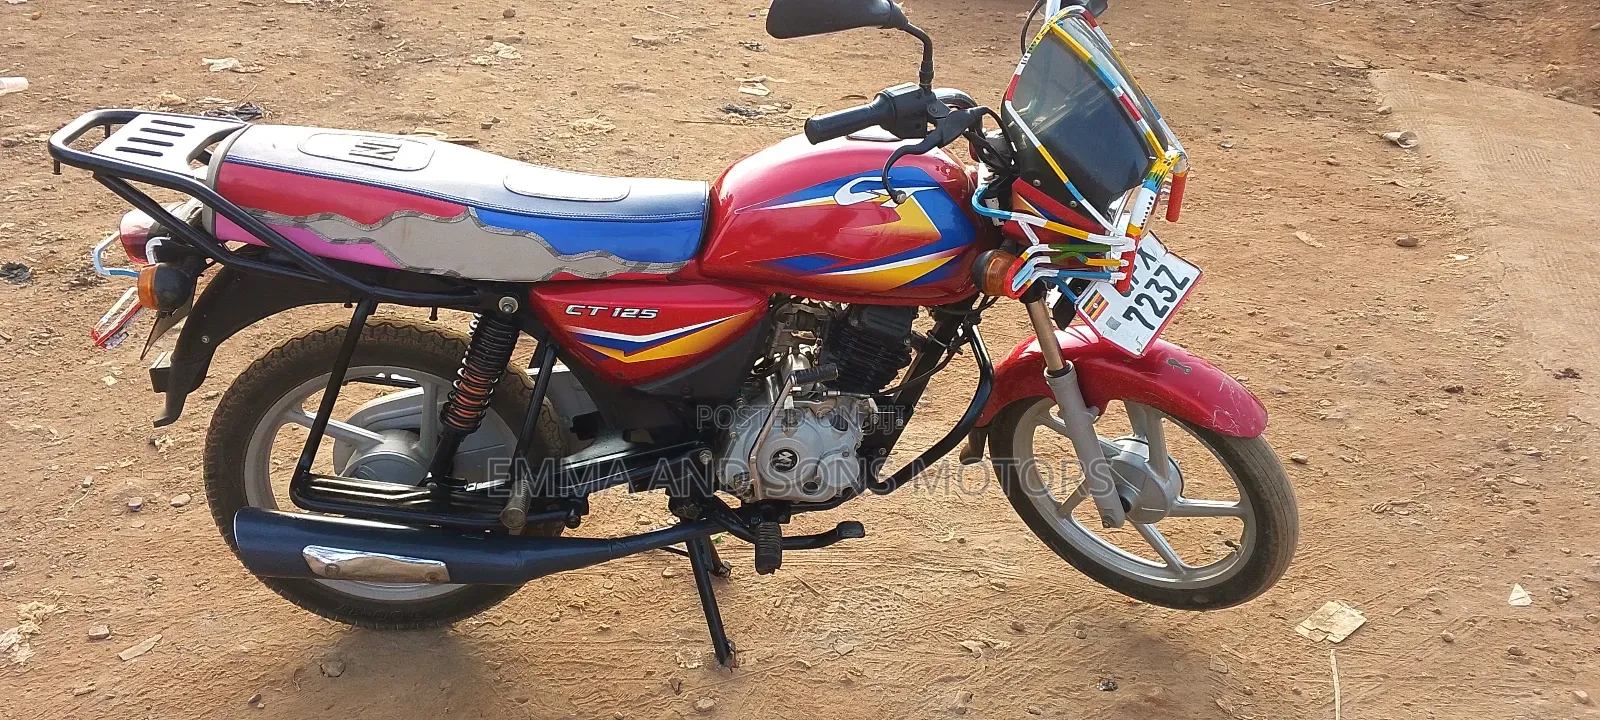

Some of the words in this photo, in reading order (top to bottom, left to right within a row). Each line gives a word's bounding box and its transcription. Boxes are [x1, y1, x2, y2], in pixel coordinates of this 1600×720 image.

[565, 304, 608, 316] CT
[612, 307, 660, 319] 125
[1122, 264, 1191, 331] 723Z
